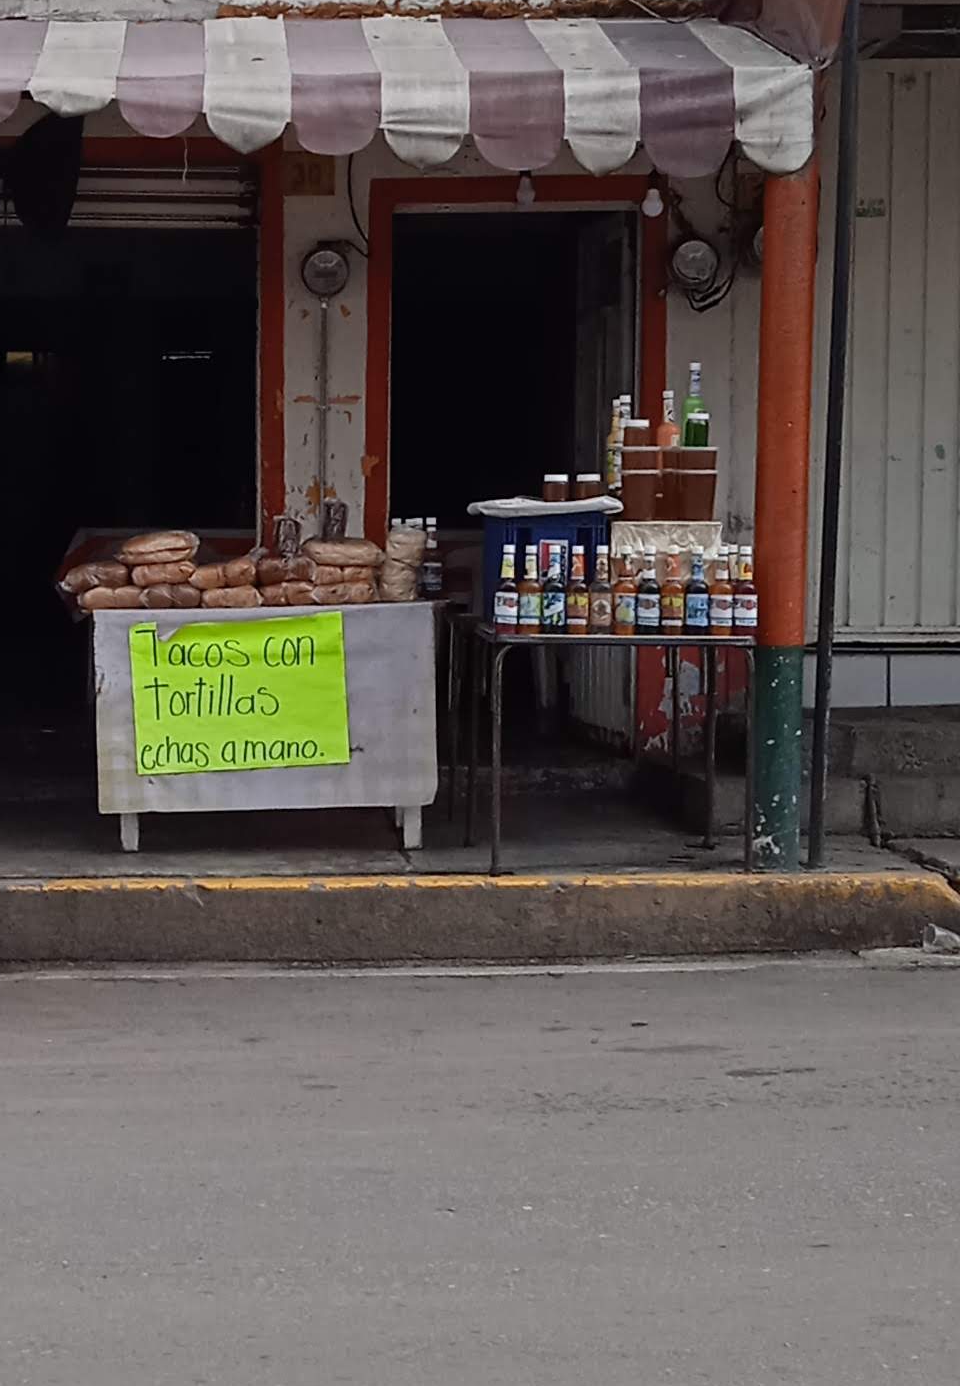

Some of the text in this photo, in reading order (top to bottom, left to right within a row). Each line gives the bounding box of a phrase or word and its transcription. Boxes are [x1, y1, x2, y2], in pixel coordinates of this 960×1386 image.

[135, 628, 315, 668] Tacos con
[140, 735, 210, 770] echas
